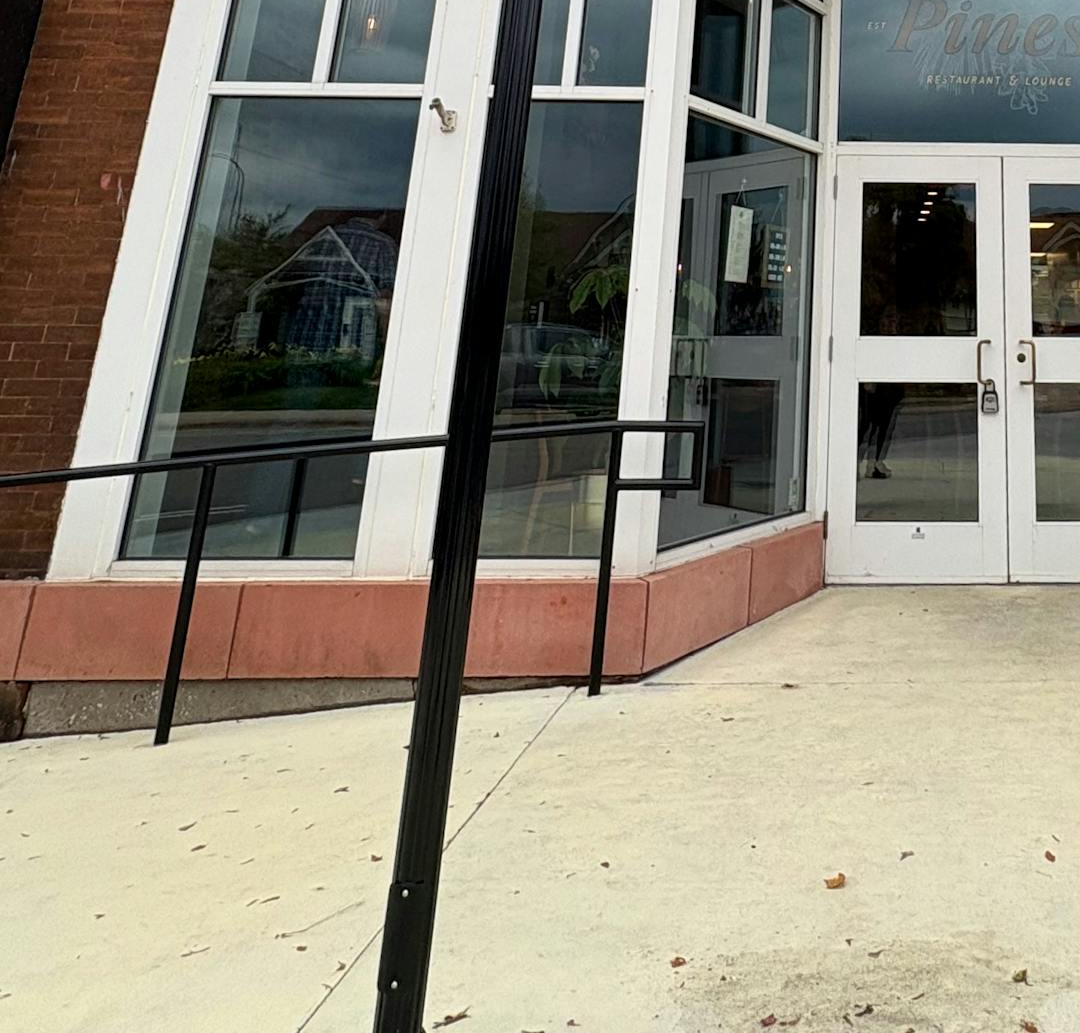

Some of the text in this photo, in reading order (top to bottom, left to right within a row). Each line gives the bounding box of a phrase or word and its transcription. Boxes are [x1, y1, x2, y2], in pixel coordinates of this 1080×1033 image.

[926, 74, 1073, 87] RESTAURANT & LOUNGE
